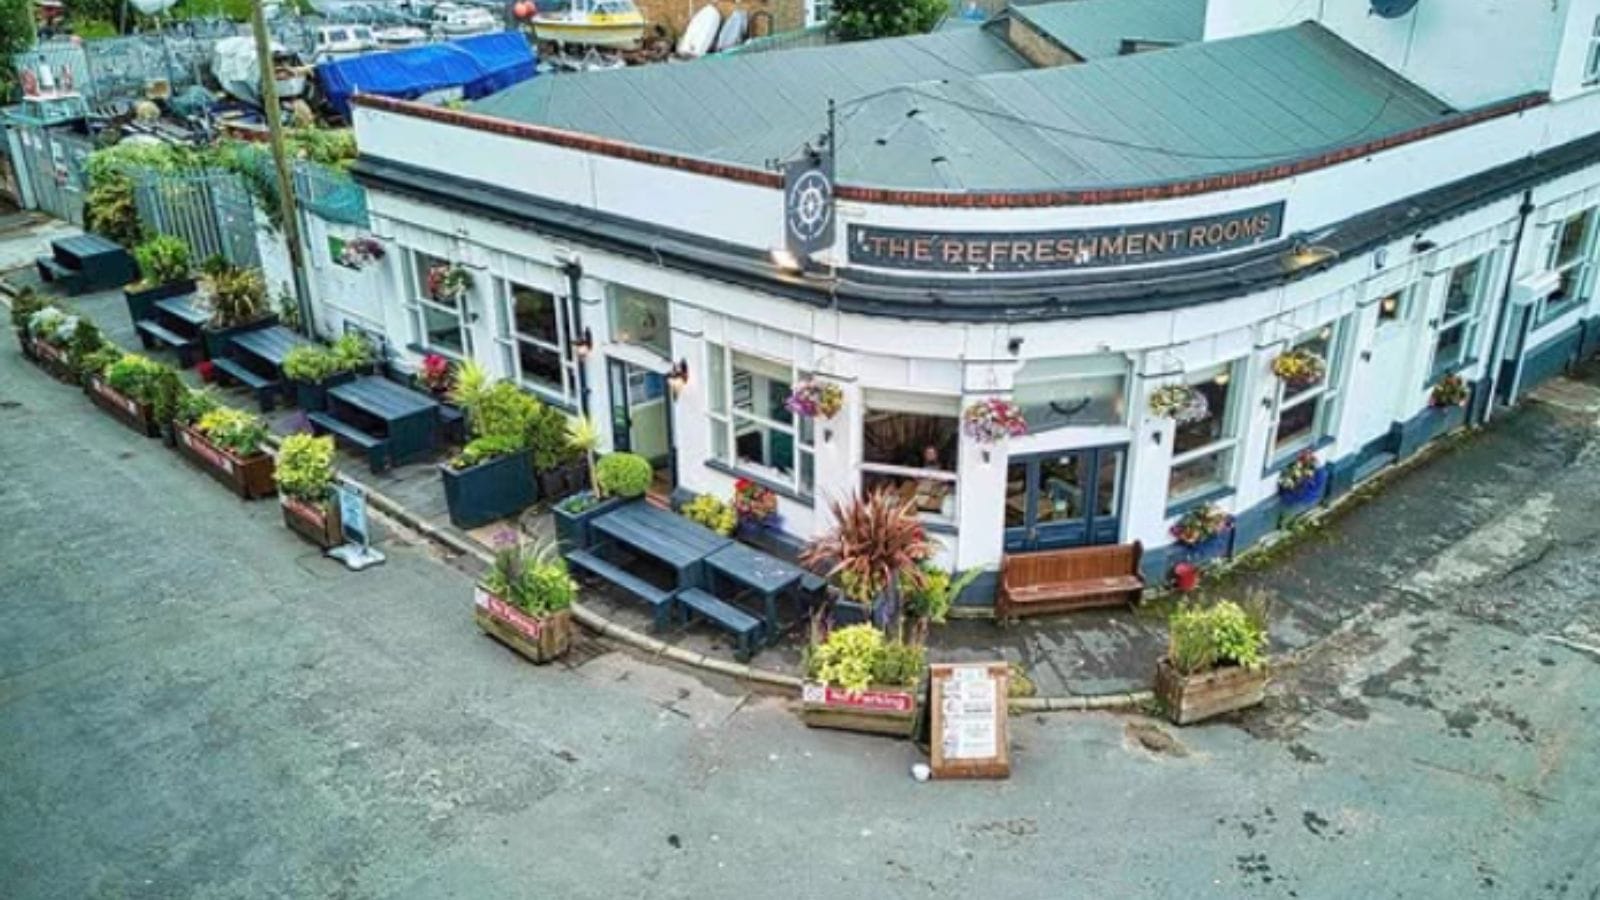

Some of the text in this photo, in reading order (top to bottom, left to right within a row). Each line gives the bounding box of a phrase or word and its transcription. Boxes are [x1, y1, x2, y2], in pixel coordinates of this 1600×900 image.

[868, 213, 1271, 263] THE REFRESHMENT ROOMS
